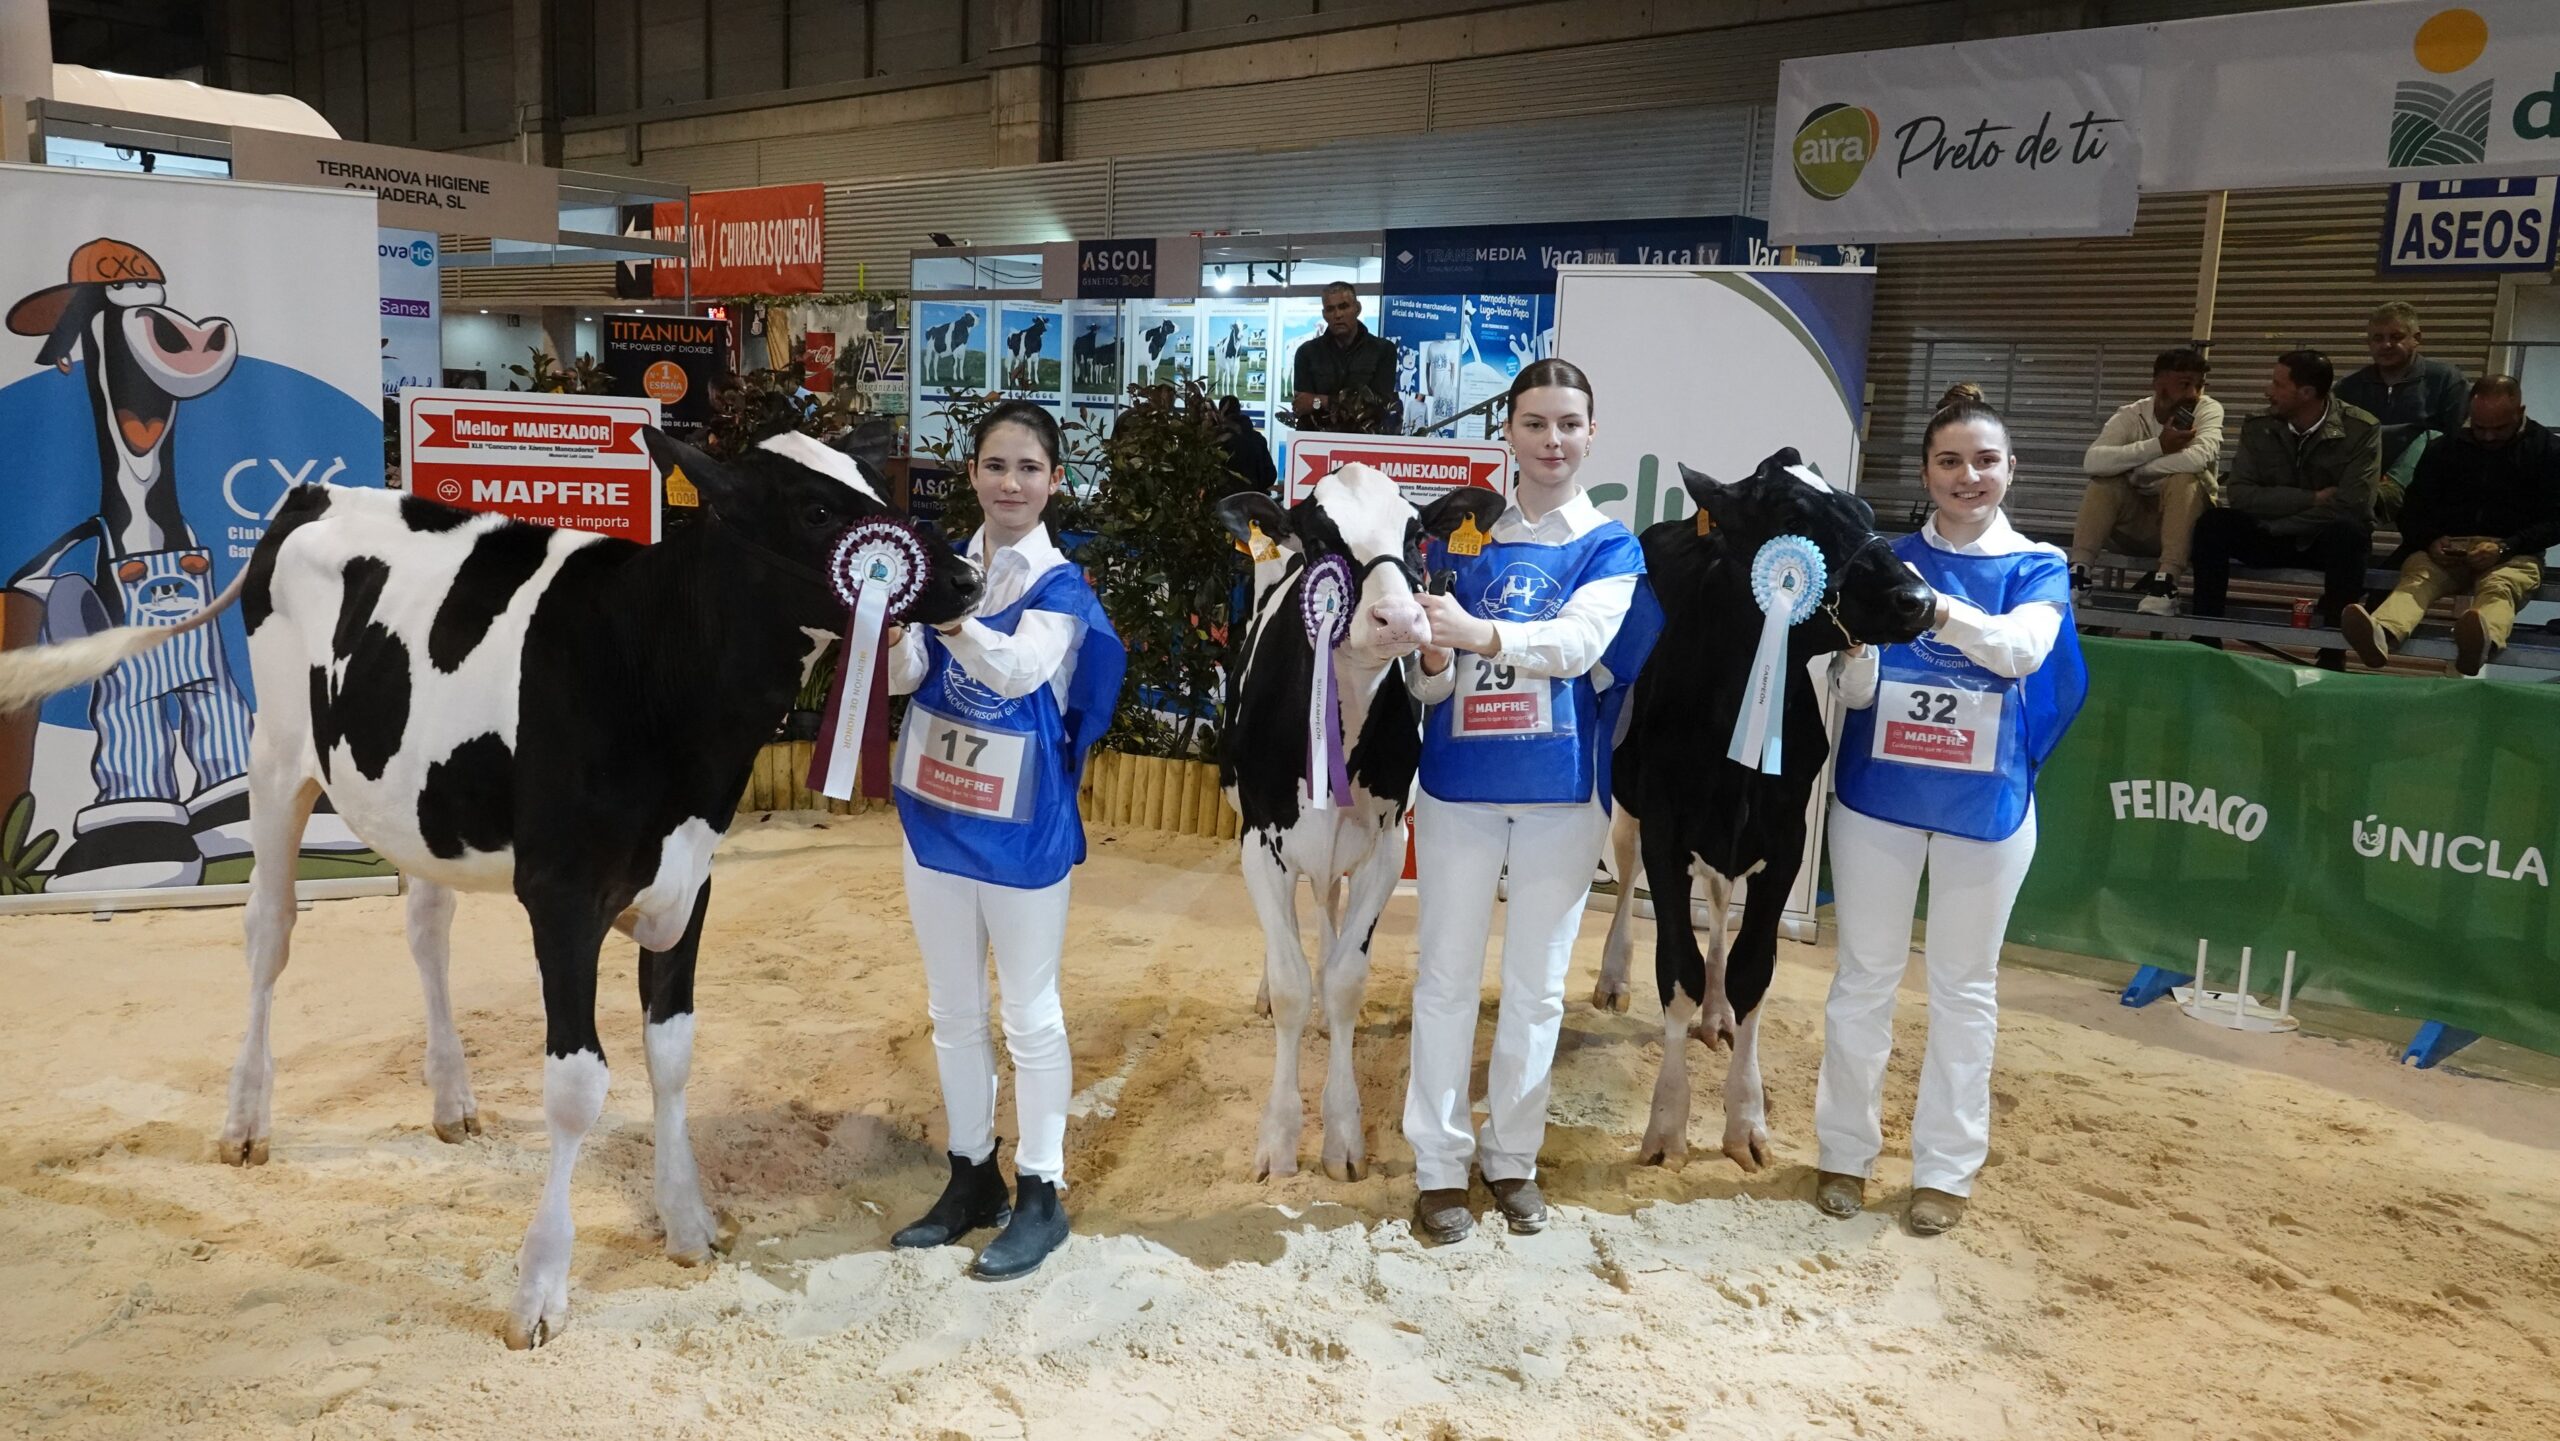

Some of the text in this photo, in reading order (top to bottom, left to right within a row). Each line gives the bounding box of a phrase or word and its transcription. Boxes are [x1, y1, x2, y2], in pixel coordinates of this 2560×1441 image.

[1800, 129, 1865, 164] aira
[1895, 110, 2124, 179] Preto de ti
[316, 160, 490, 194] TERRANOVA HIGIENE
[446, 194, 466, 210] SL
[719, 204, 822, 276] CHURRASQUERÍA
[2397, 208, 2542, 260] ASEOS
[96, 254, 148, 278] CXG
[1082, 250, 1152, 271] ASCOL
[1540, 246, 1617, 269] Vaca PINTA
[1082, 276, 1119, 286] GENETICS
[381, 300, 428, 316] Sanex
[1392, 299, 1400, 307] La
[1415, 301, 1422, 309] de
[1422, 302, 1457, 314] merchandising
[1407, 310, 1414, 318] de
[1415, 311, 1426, 319] Vaca
[1426, 312, 1440, 320] Pinta
[610, 322, 714, 344] TITANIUM
[610, 342, 714, 354] THE POWER OF DIOXIDE
[456, 419, 610, 441] Mellor MANEXADOR
[1380, 463, 1468, 481] MANEXADOR
[471, 479, 630, 506] MAPFRE
[228, 526, 265, 540] Club
[559, 515, 573, 526] te
[576, 515, 630, 530] importa
[1449, 543, 1478, 554] 5519
[1935, 658, 1970, 669] FRISONA
[1475, 660, 1516, 691] 29
[1758, 664, 1771, 705] CAMPEÓN
[969, 708, 1003, 721] FRISONA
[1475, 701, 1530, 714] MAPFRE
[1907, 690, 1957, 725] 32
[941, 729, 989, 768] 17
[1904, 730, 1966, 747] MAPFRE
[934, 769, 995, 794] MAPFRE
[2109, 779, 2268, 842] FEIRACO
[2358, 831, 2380, 846] A2
[2352, 814, 2549, 887] ÚNICLA
